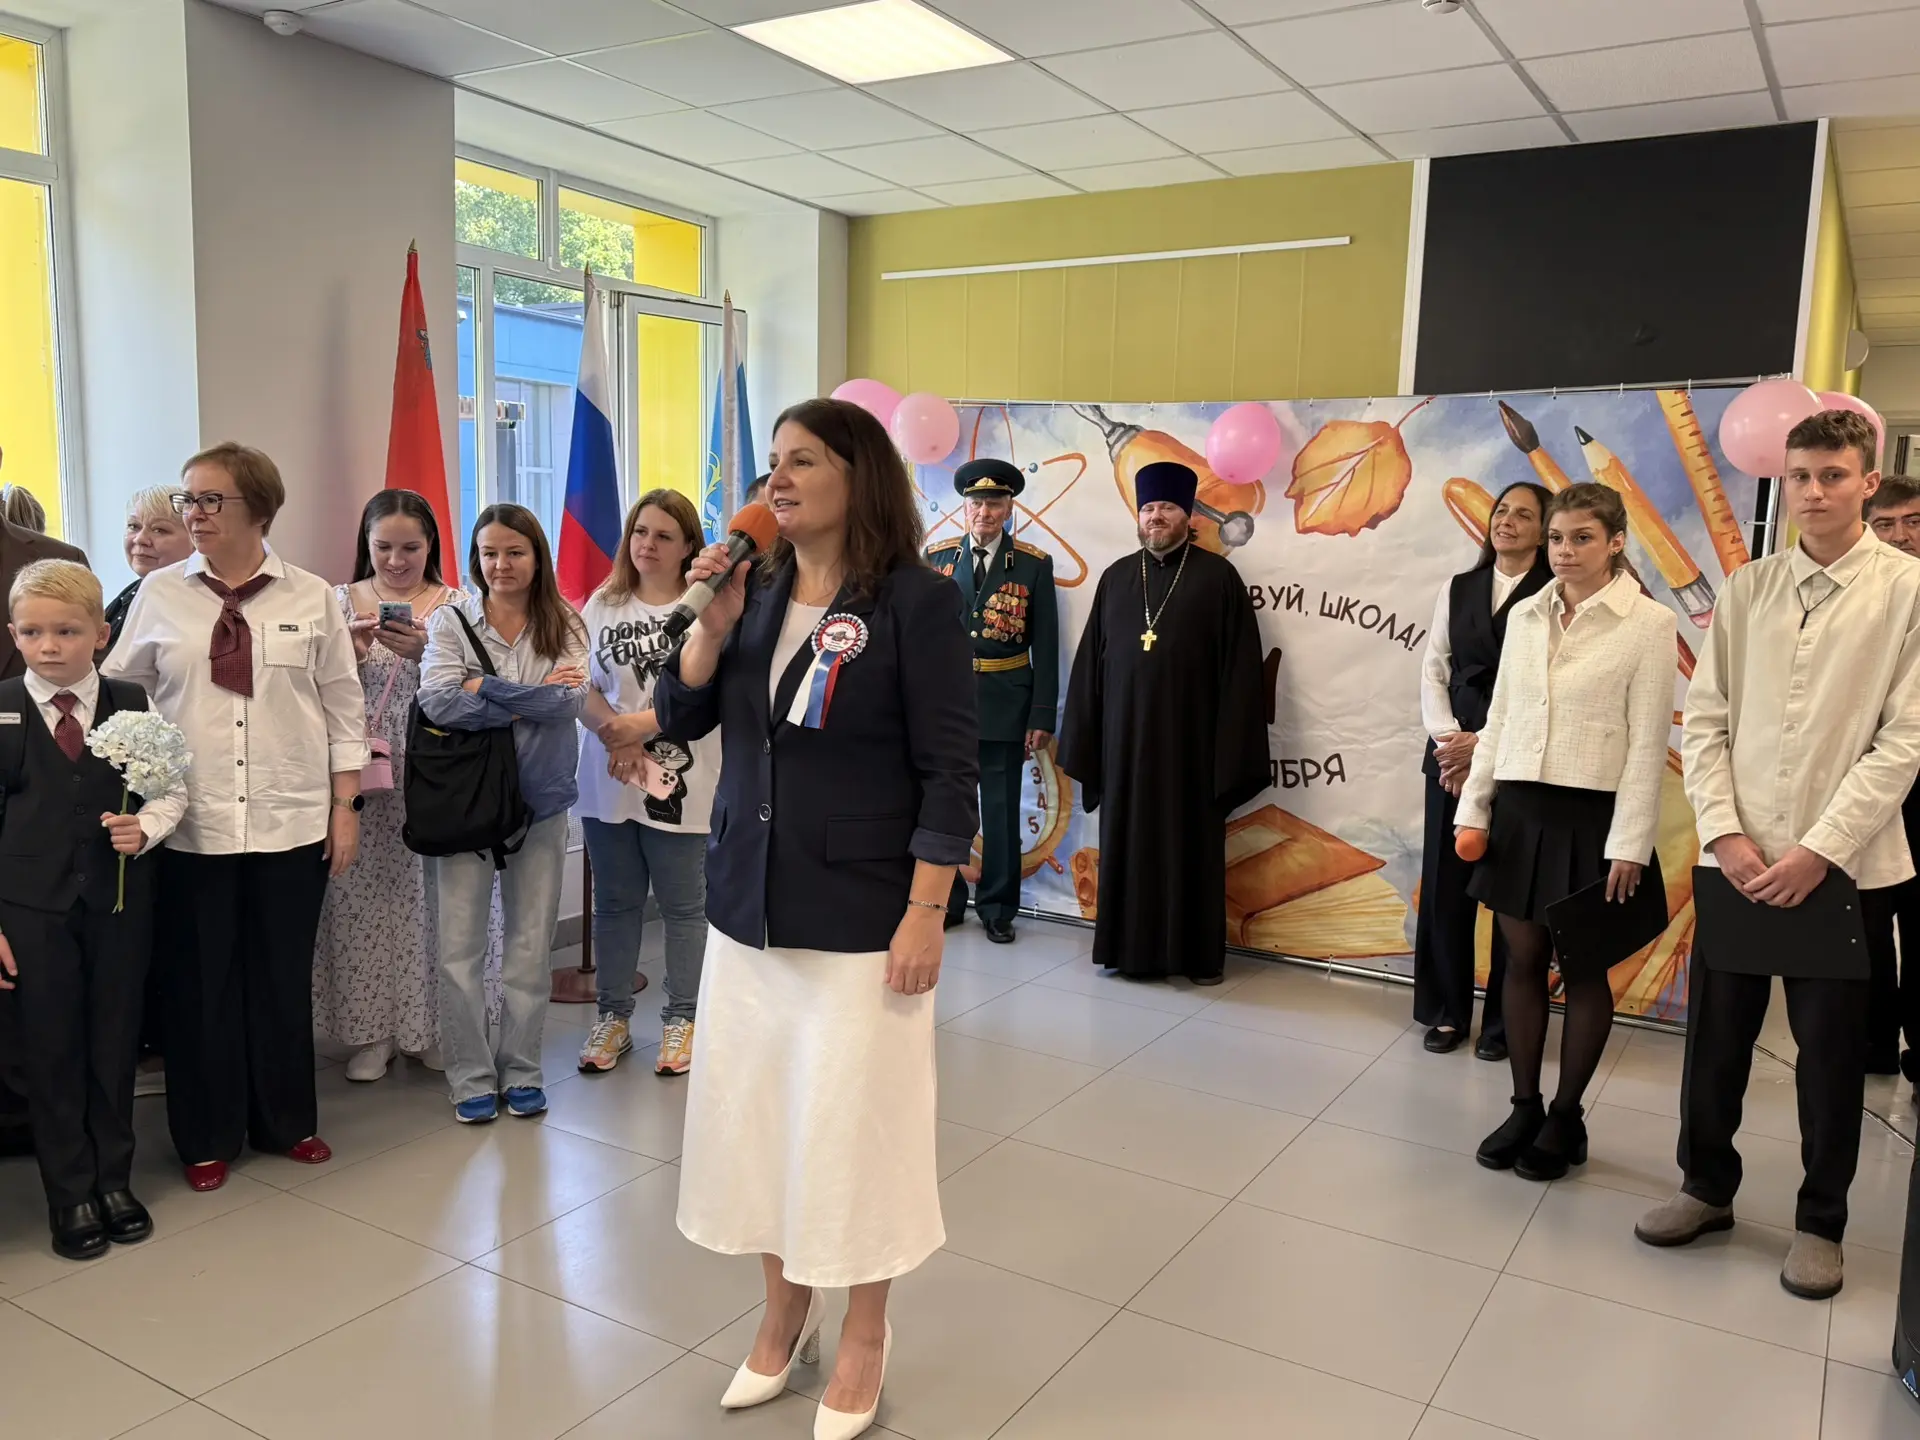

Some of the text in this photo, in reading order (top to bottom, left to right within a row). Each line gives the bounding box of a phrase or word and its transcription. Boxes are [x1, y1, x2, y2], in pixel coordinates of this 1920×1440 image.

[1247, 583, 1426, 651] ВУЙ, ШКОЛА!
[1030, 766, 1043, 785] 3
[1028, 816, 1040, 834] 5
